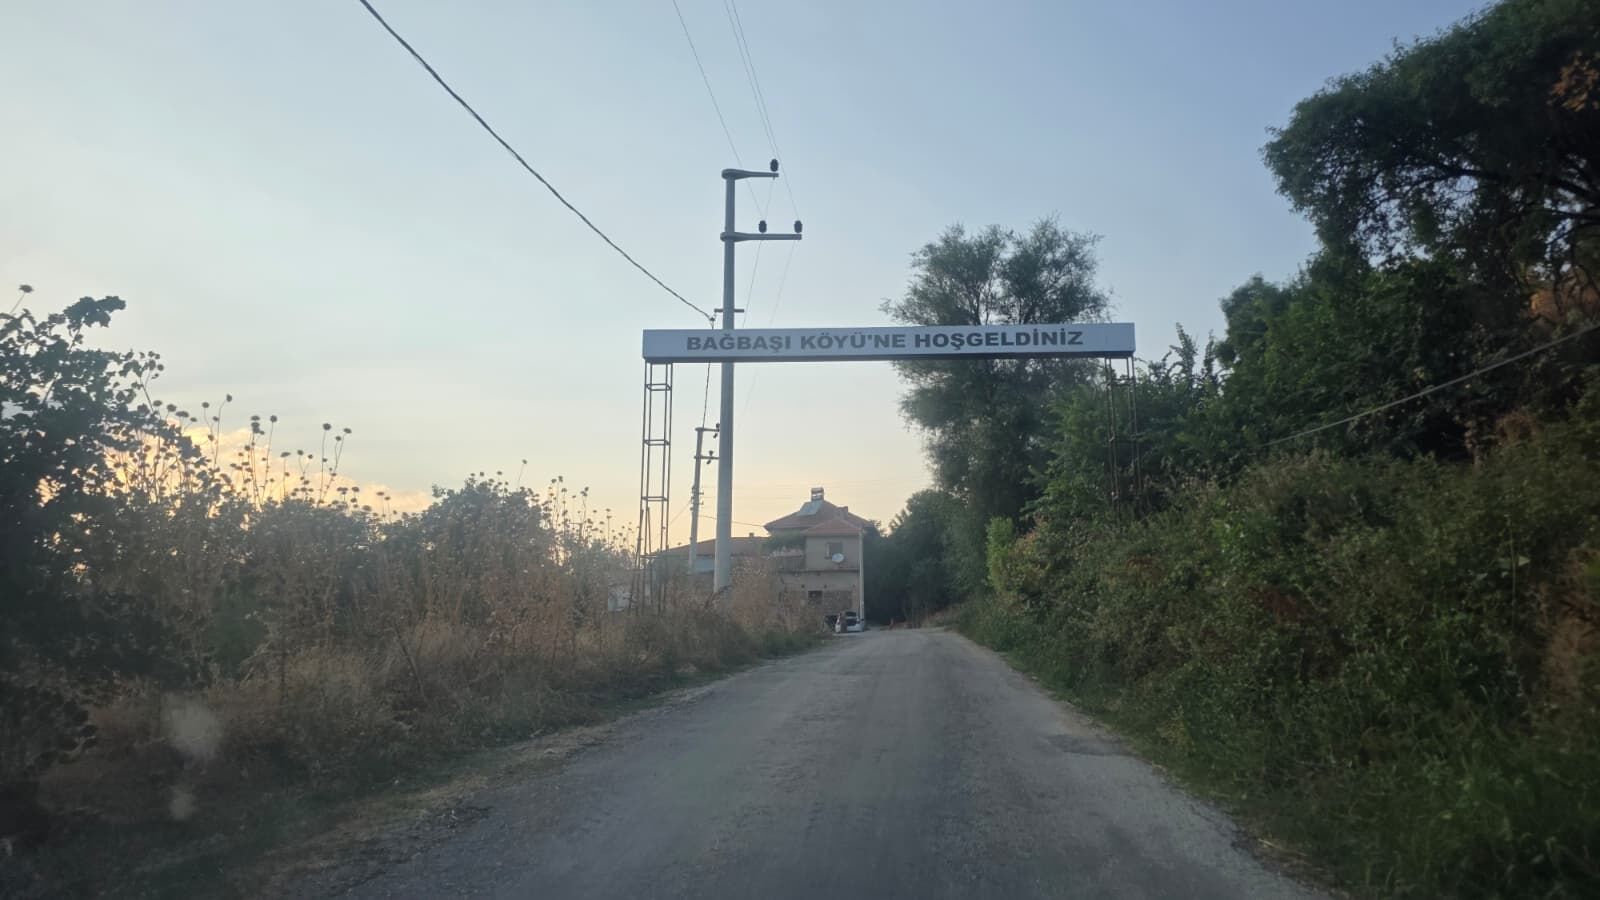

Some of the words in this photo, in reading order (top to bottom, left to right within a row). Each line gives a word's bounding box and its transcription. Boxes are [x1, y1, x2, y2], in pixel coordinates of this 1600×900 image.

[686, 333, 791, 352] BAĞBAŞI
[801, 331, 906, 350] KÖYÜ'NE
[914, 328, 1084, 350] HOŞGELDİNİZ
